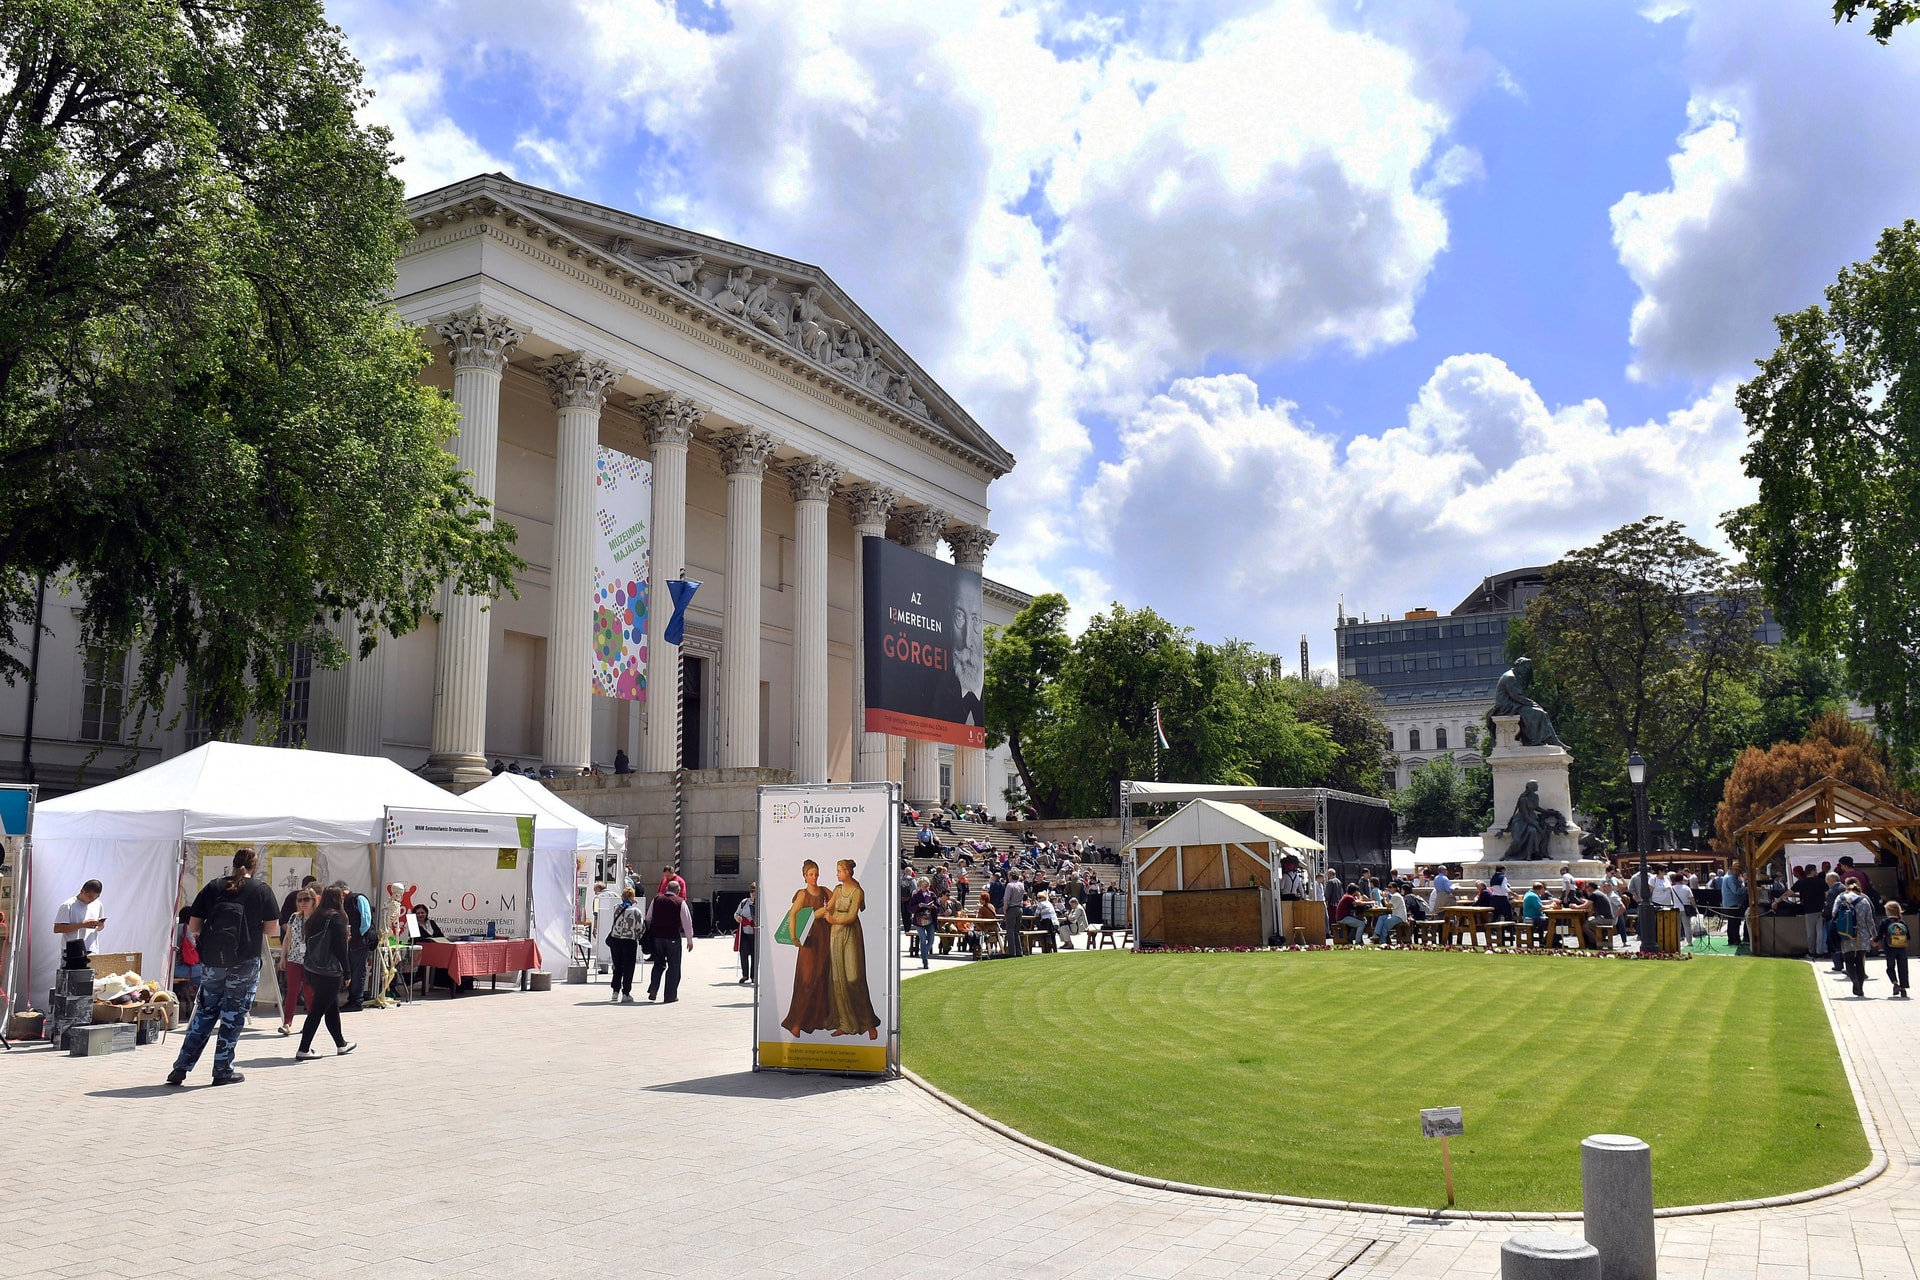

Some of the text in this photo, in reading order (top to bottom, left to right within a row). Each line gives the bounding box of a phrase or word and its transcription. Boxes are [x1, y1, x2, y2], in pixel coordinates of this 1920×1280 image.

[608, 520, 646, 551] MÚZEUMOK
[613, 535, 647, 563] MAJÁLISA
[910, 591, 922, 605] AZ
[883, 631, 948, 672] GÖRGEI
[803, 804, 865, 814] Múzeumok
[803, 815, 851, 825] Majálisa
[803, 831, 821, 839] 2019.
[823, 831, 834, 839] 05.
[428, 891, 516, 912] S O M
